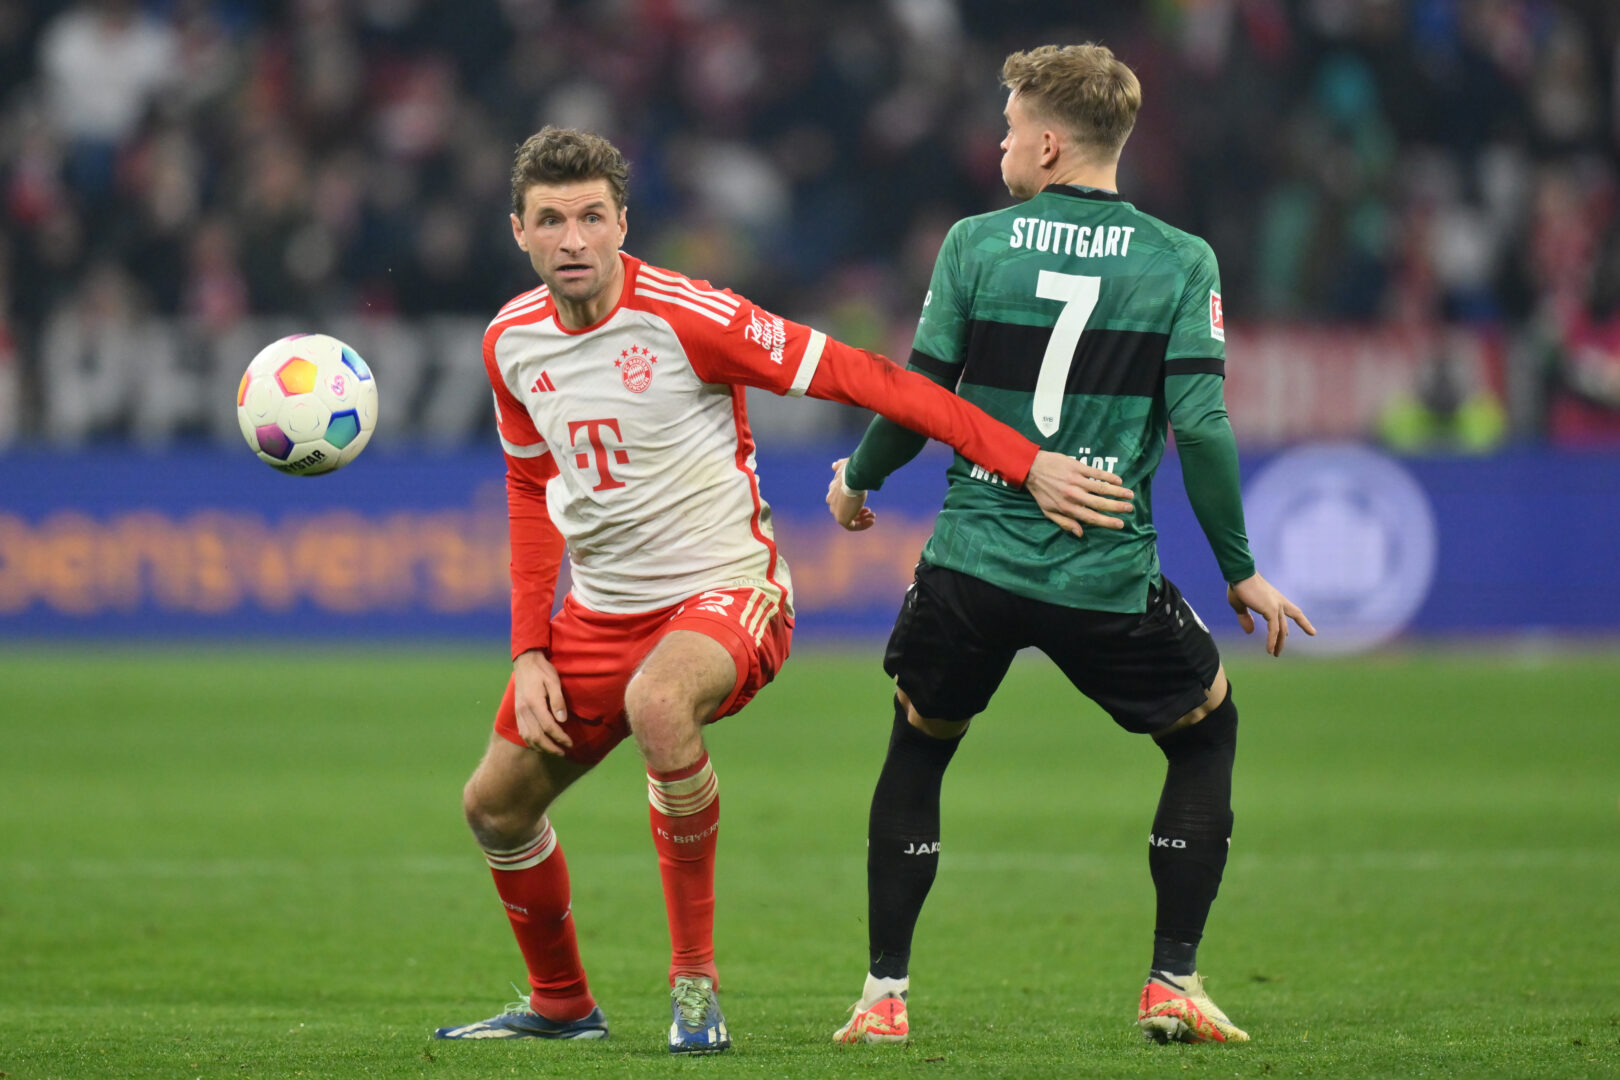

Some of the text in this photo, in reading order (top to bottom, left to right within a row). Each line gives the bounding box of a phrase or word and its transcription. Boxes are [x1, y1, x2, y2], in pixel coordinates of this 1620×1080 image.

[1009, 216, 1135, 258] STUTTGART
[1032, 269, 1101, 438] 7
[1149, 833, 1186, 848] AKO
